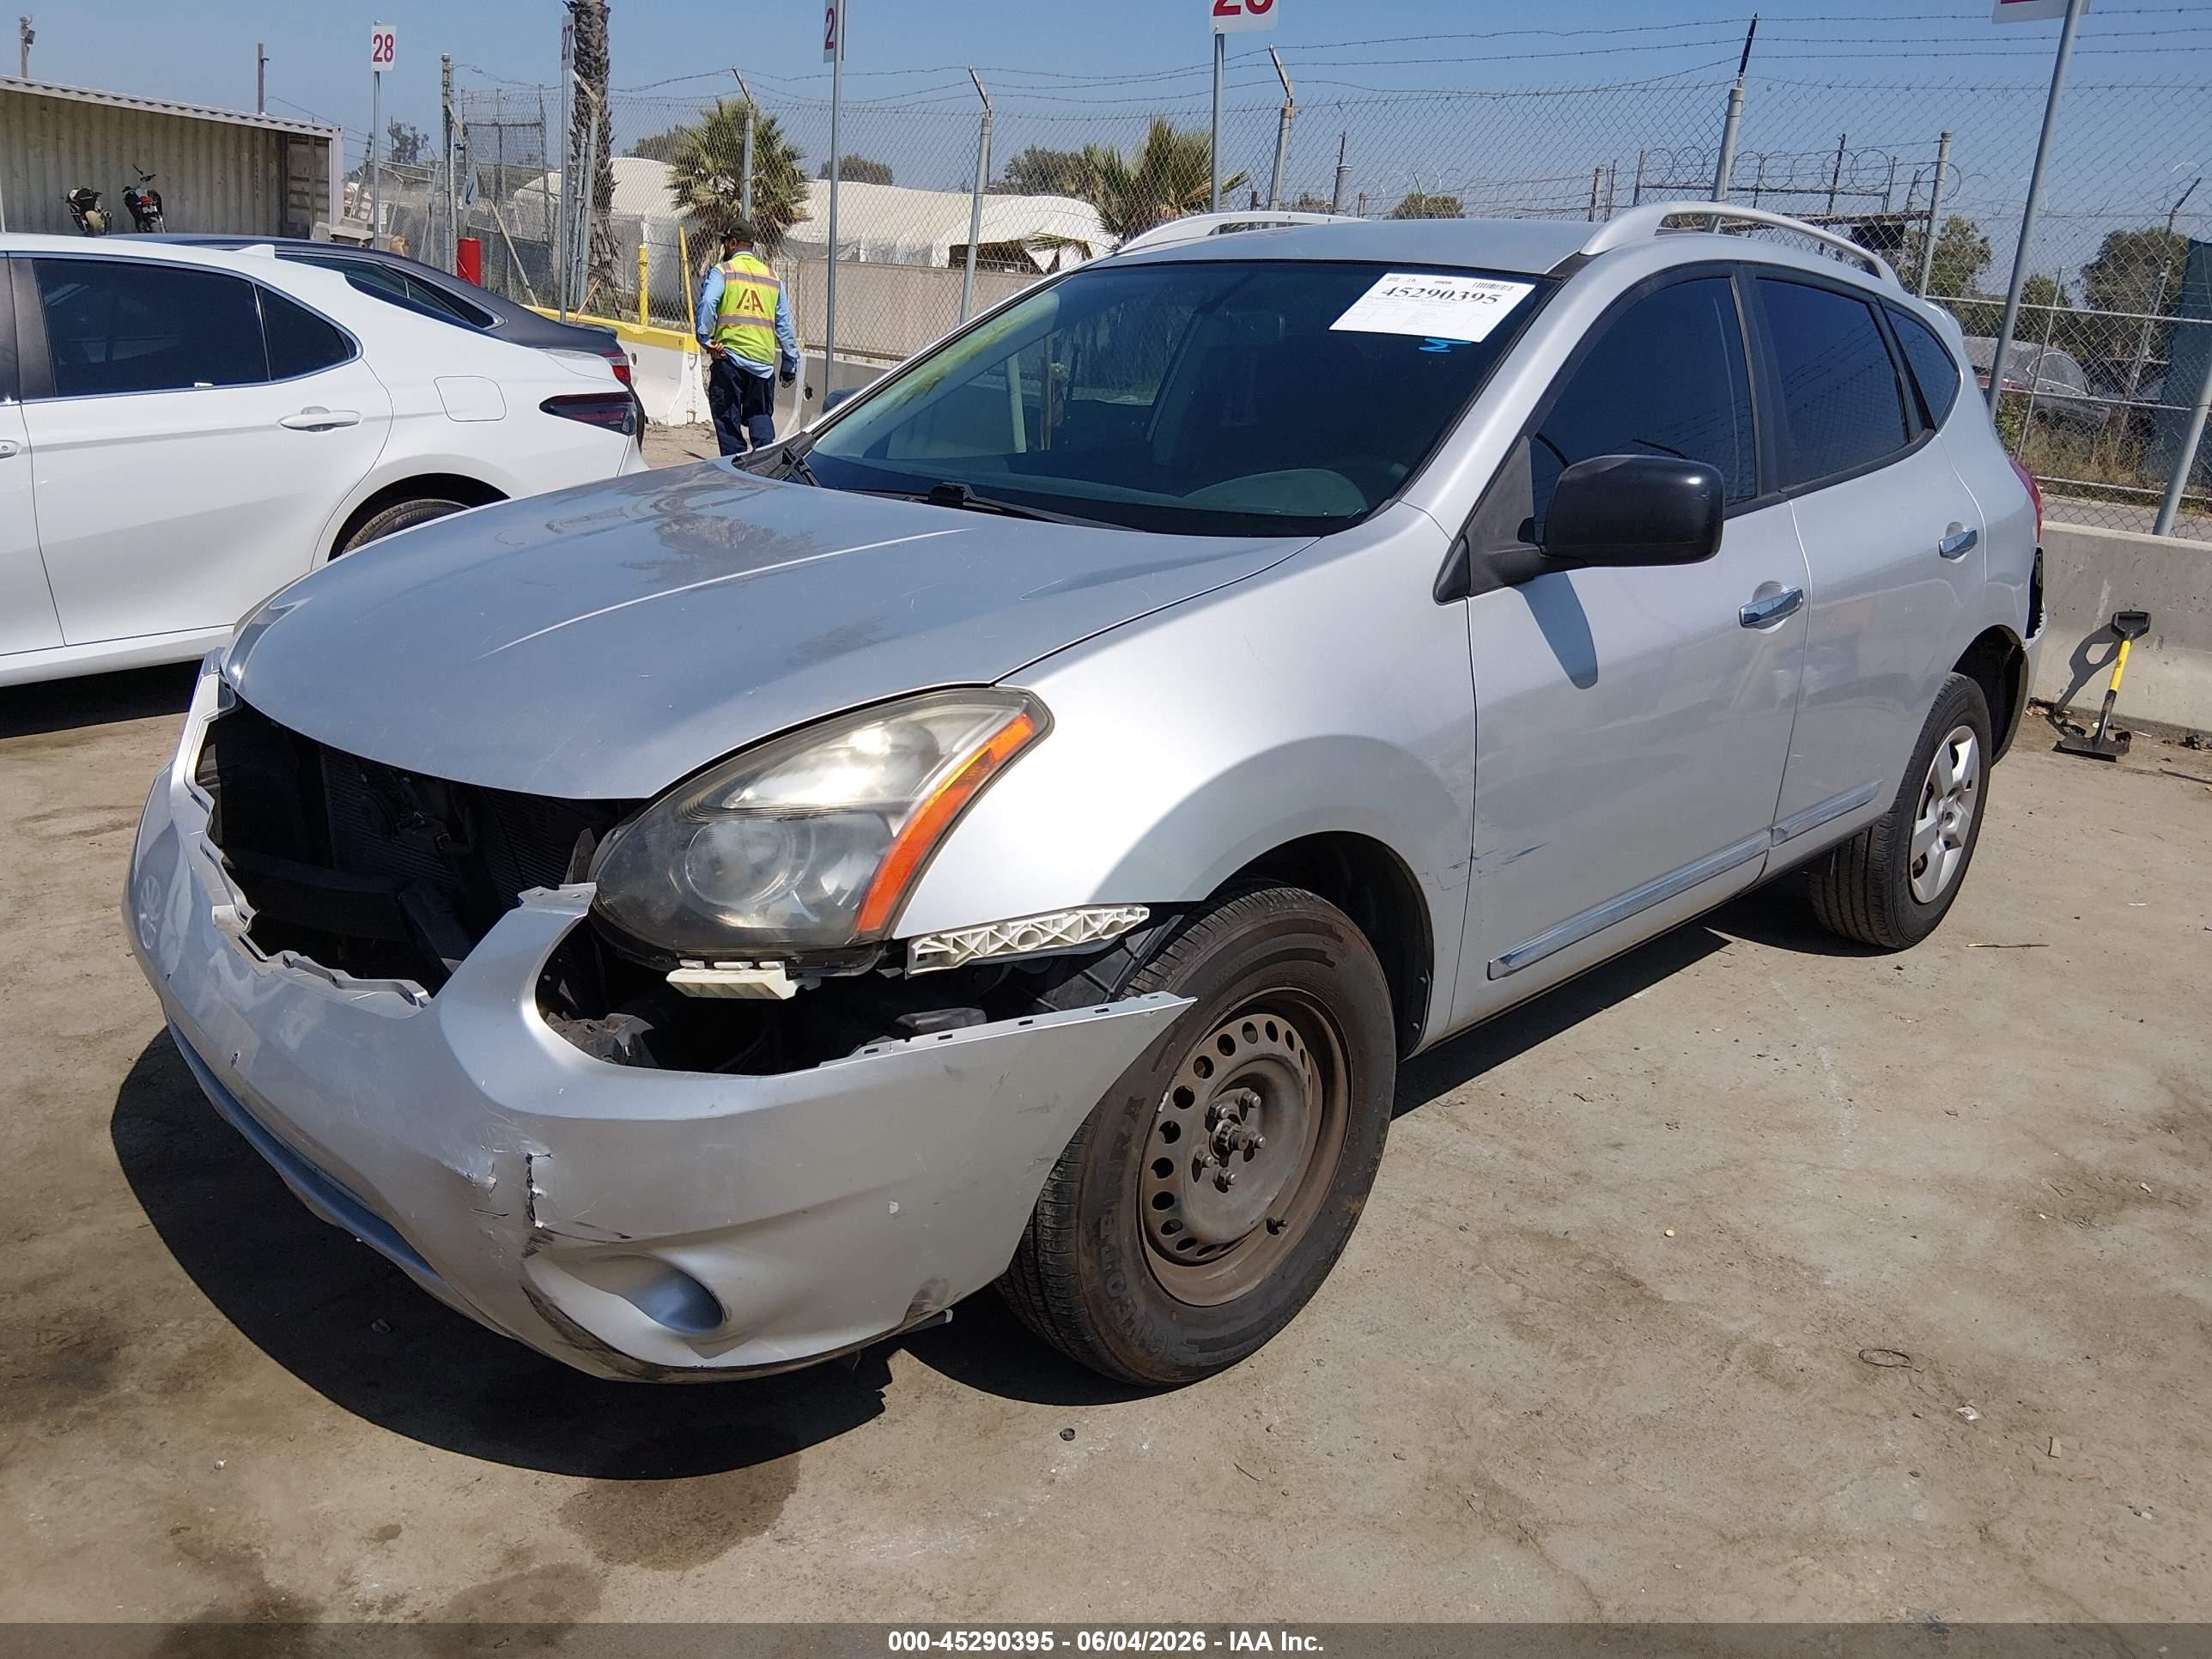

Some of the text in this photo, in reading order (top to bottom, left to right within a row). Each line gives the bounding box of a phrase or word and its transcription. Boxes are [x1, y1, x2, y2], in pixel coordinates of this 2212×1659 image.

[824, 8, 835, 49] 2
[373, 33, 393, 62] 28
[1381, 286, 1504, 305] 45290395
